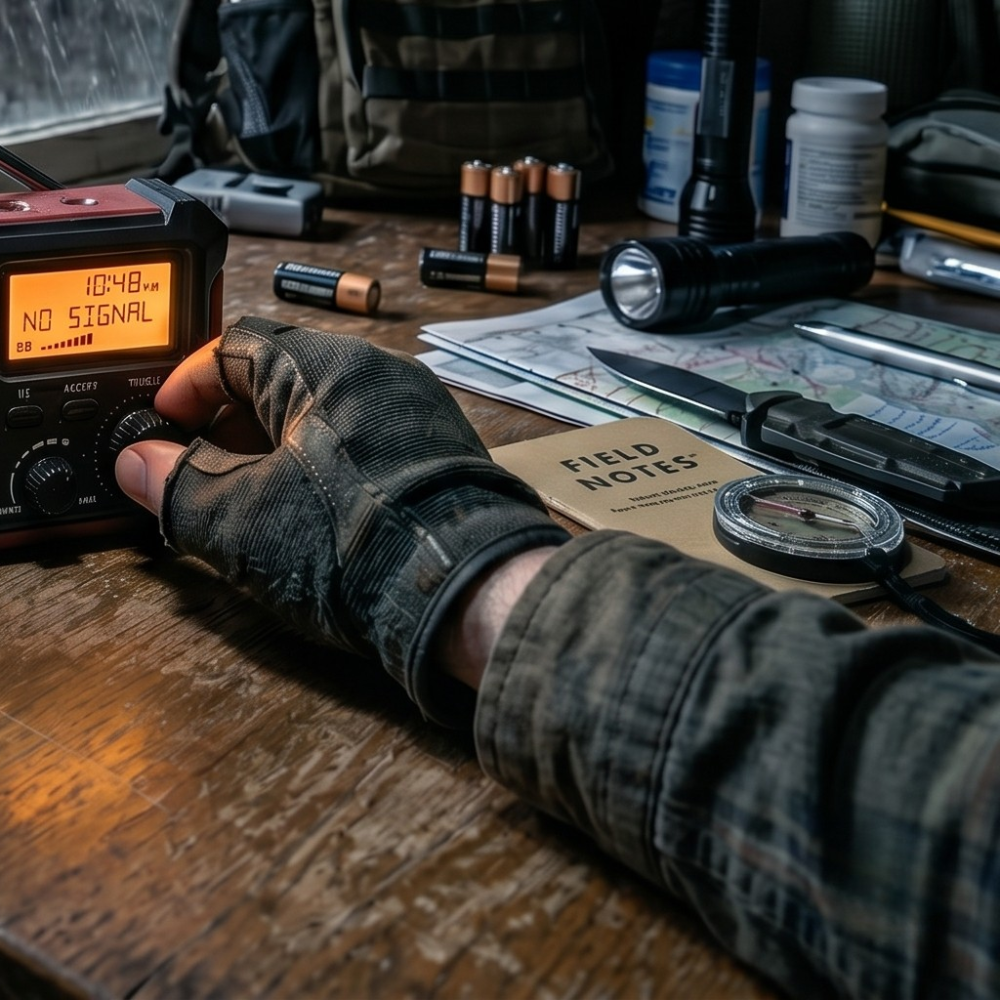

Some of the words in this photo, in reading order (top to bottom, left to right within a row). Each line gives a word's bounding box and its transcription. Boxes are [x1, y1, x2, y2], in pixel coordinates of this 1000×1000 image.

[86, 271, 141, 296] 10:48
[23, 309, 52, 332] NO
[69, 301, 153, 329] SIGNAL
[559, 443, 660, 473] FIELD
[575, 455, 699, 491] NOTES
